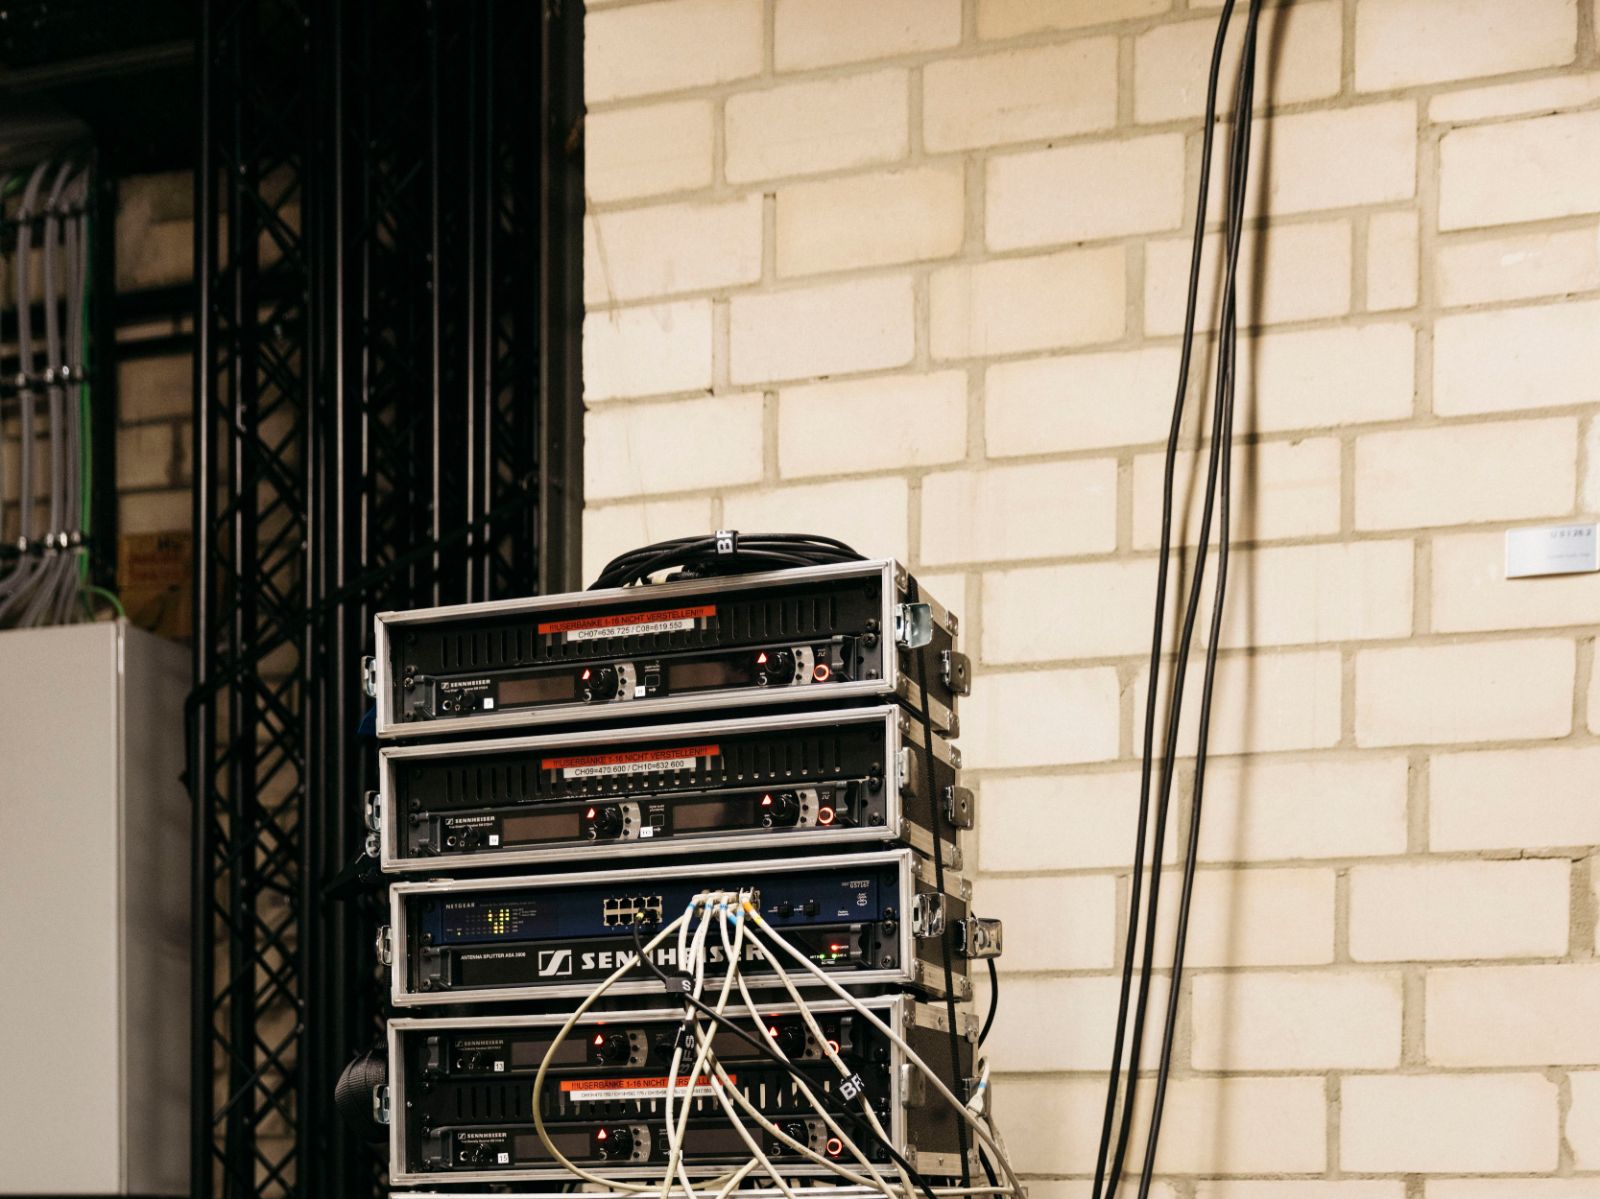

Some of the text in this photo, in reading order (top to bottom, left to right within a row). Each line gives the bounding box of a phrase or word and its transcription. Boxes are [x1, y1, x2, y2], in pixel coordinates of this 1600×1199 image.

[621, 615, 644, 624] NICHT
[450, 679, 491, 688] SENNHEISER
[625, 753, 649, 762] NICHT
[455, 816, 496, 824] SENNHEISER
[445, 902, 475, 910] NETGEAR
[464, 1039, 504, 1047] SENNHEISER
[642, 1079, 665, 1087] NICHT
